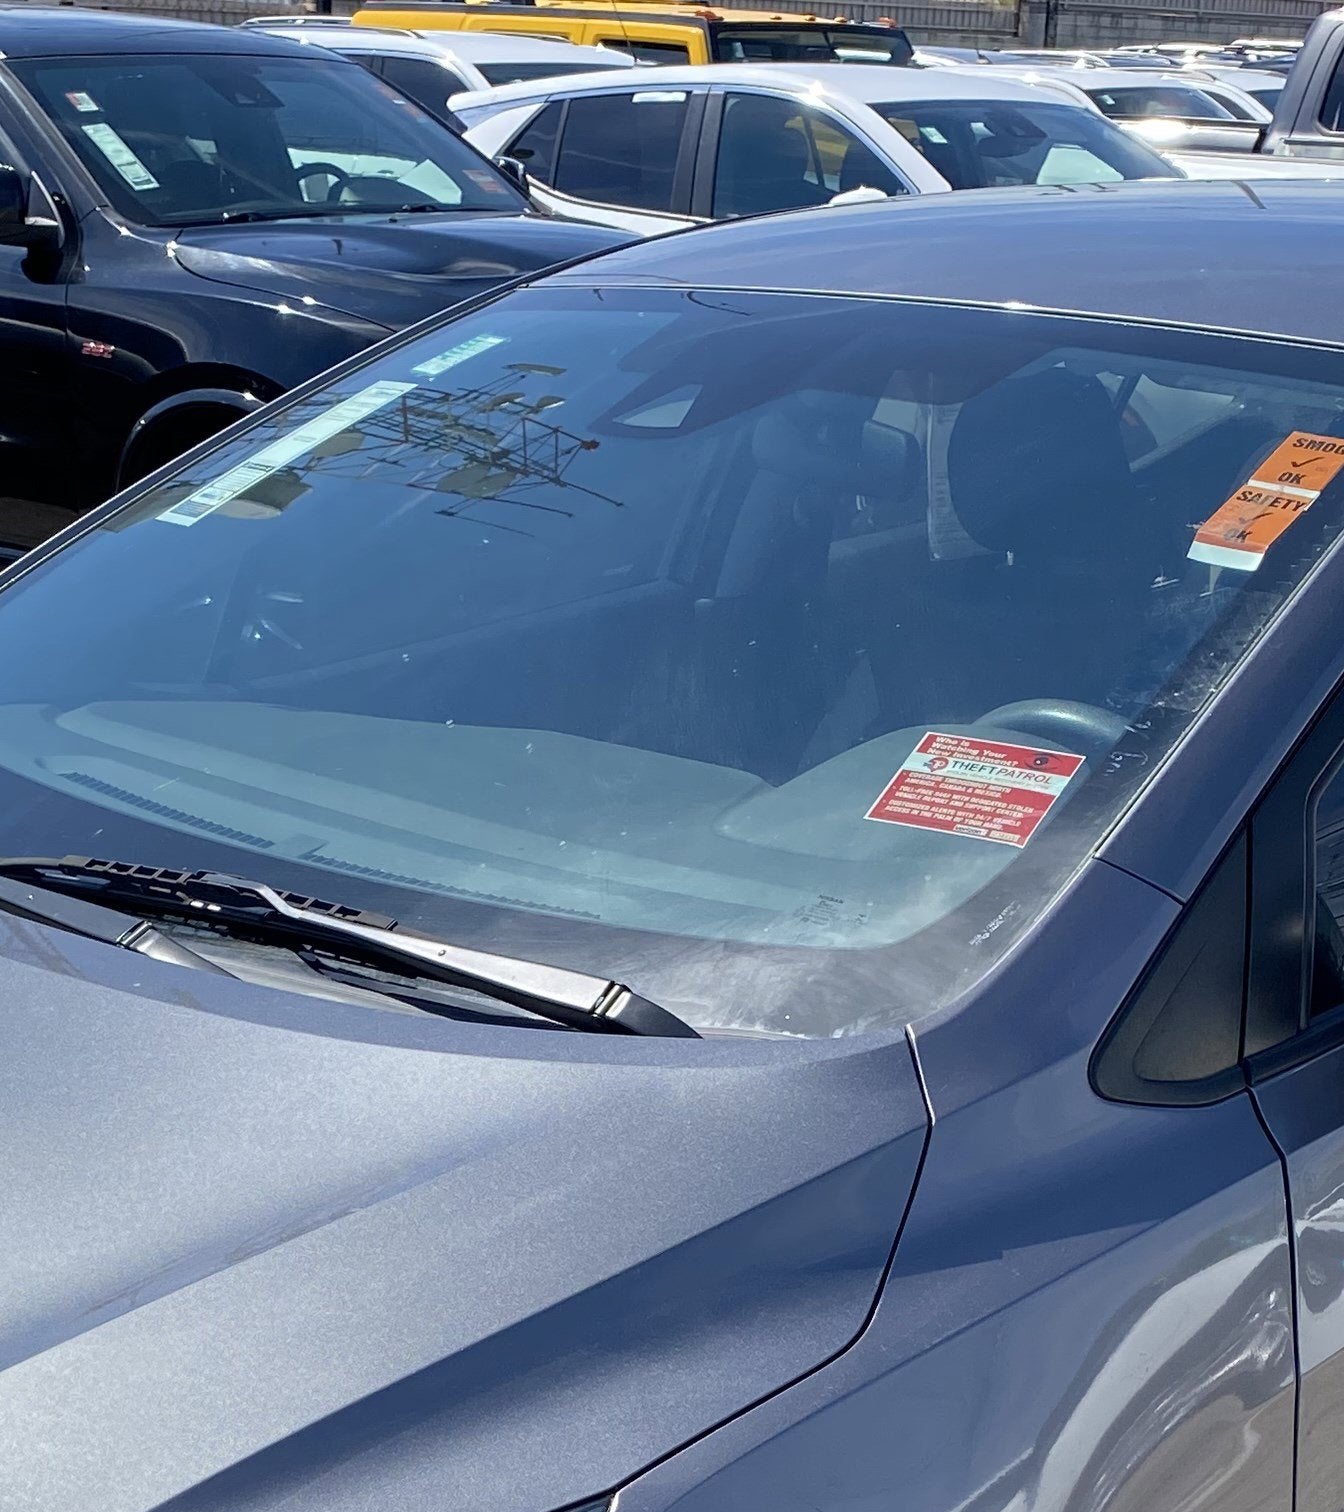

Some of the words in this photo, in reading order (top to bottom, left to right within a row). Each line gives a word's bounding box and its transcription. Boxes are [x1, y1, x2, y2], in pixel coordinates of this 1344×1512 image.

[1277, 471, 1307, 485] OK
[1236, 490, 1308, 512] SAFETY
[1223, 527, 1253, 543] OK
[936, 736, 958, 745] Who
[927, 747, 951, 757] New
[931, 742, 980, 755] Watching
[982, 748, 1007, 759] Your
[951, 793, 971, 802] WITH
[1007, 803, 1034, 813] STOLEN
[956, 811, 975, 819] WITH
